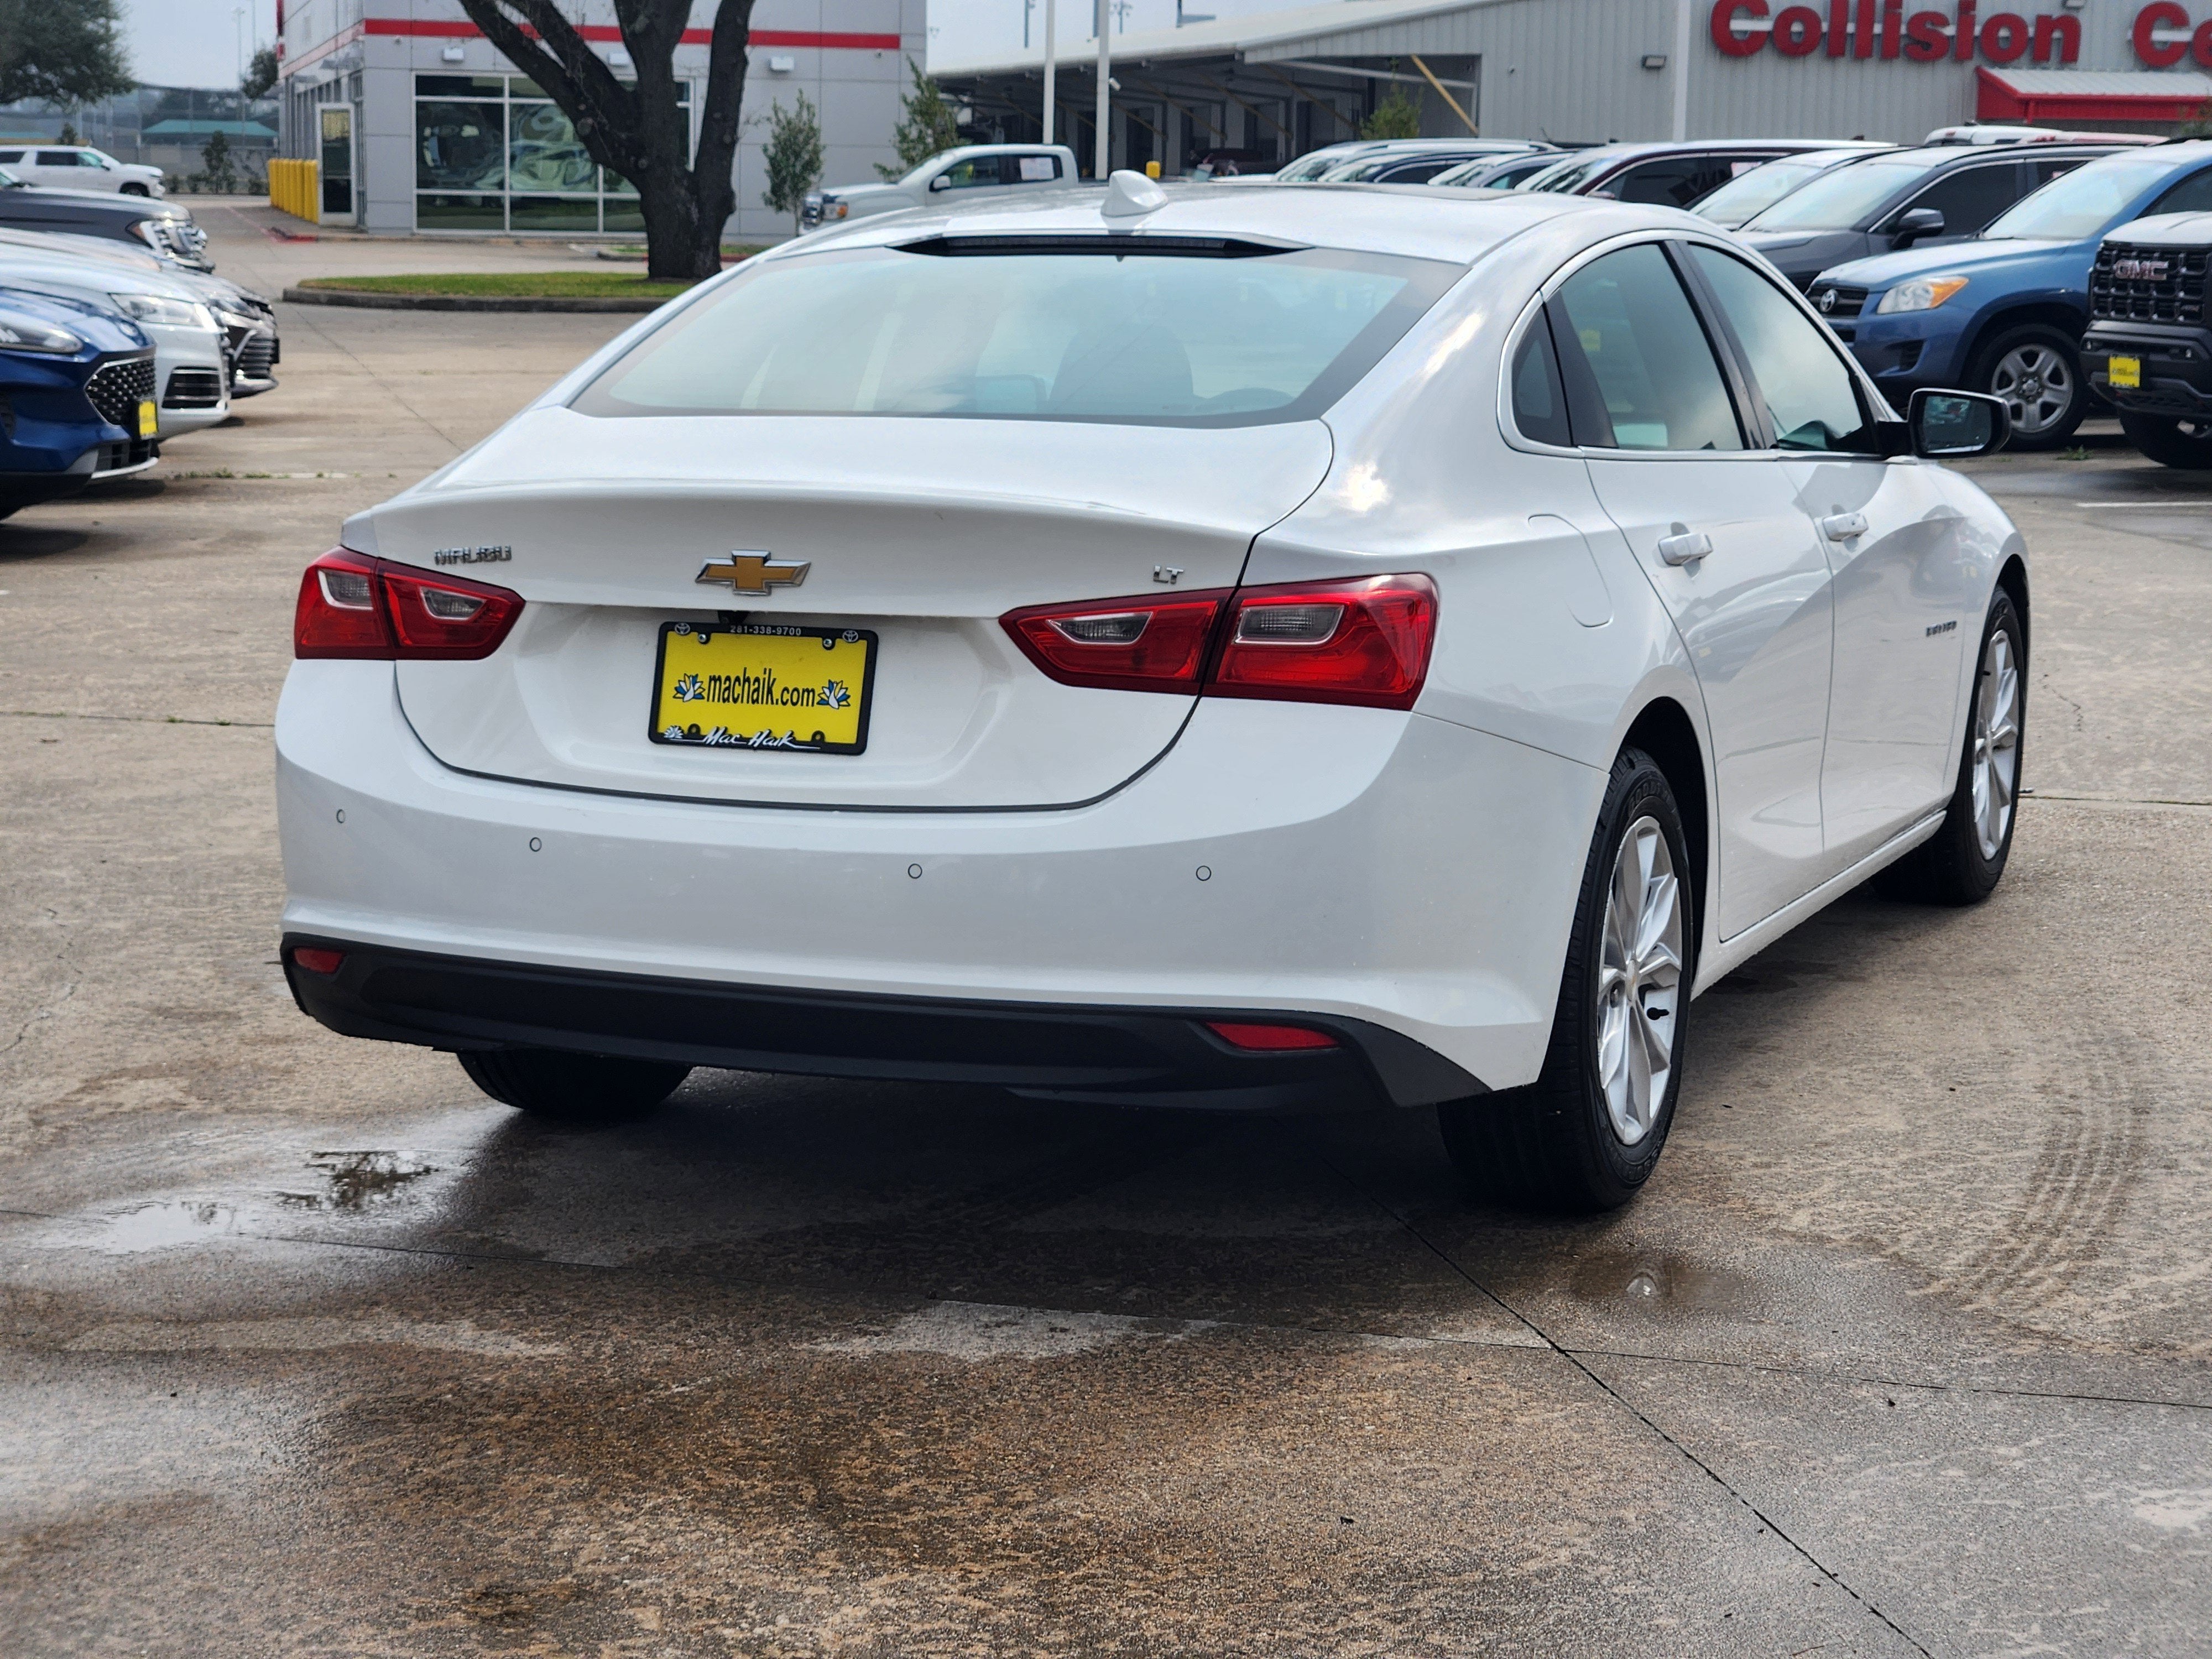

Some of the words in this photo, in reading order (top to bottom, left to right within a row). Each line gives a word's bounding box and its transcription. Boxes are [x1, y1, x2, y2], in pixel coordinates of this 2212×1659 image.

[1710, 0, 2082, 64] Collision
[2114, 259, 2169, 280] GMC
[434, 545, 512, 565] MALIBU
[1153, 565, 1184, 585] LT
[730, 625, 802, 636] 281-338-9700
[707, 667, 816, 707] machaik.com
[702, 726, 747, 745] Mac
